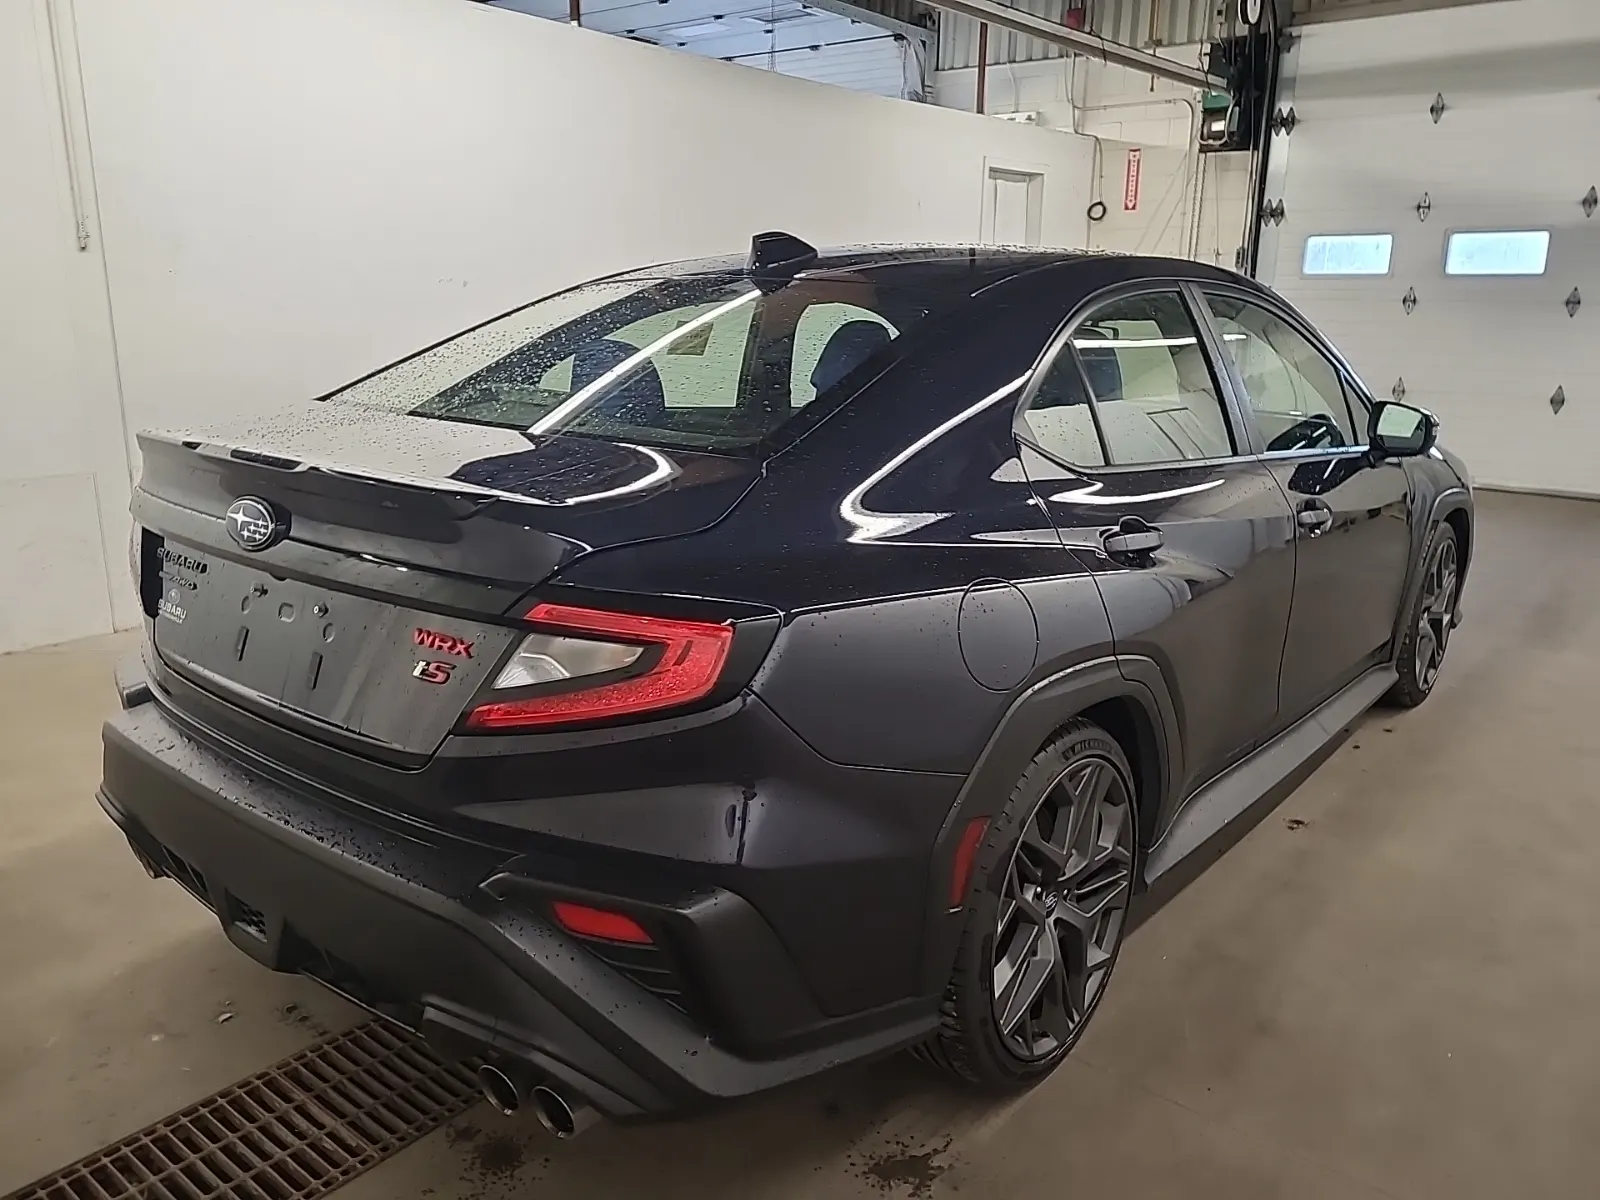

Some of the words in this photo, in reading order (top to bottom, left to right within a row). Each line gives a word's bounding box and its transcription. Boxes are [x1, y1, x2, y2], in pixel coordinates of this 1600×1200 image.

[157, 547, 209, 574] SUBARU
[158, 599, 187, 619] SUBARU
[413, 627, 475, 660] WRX
